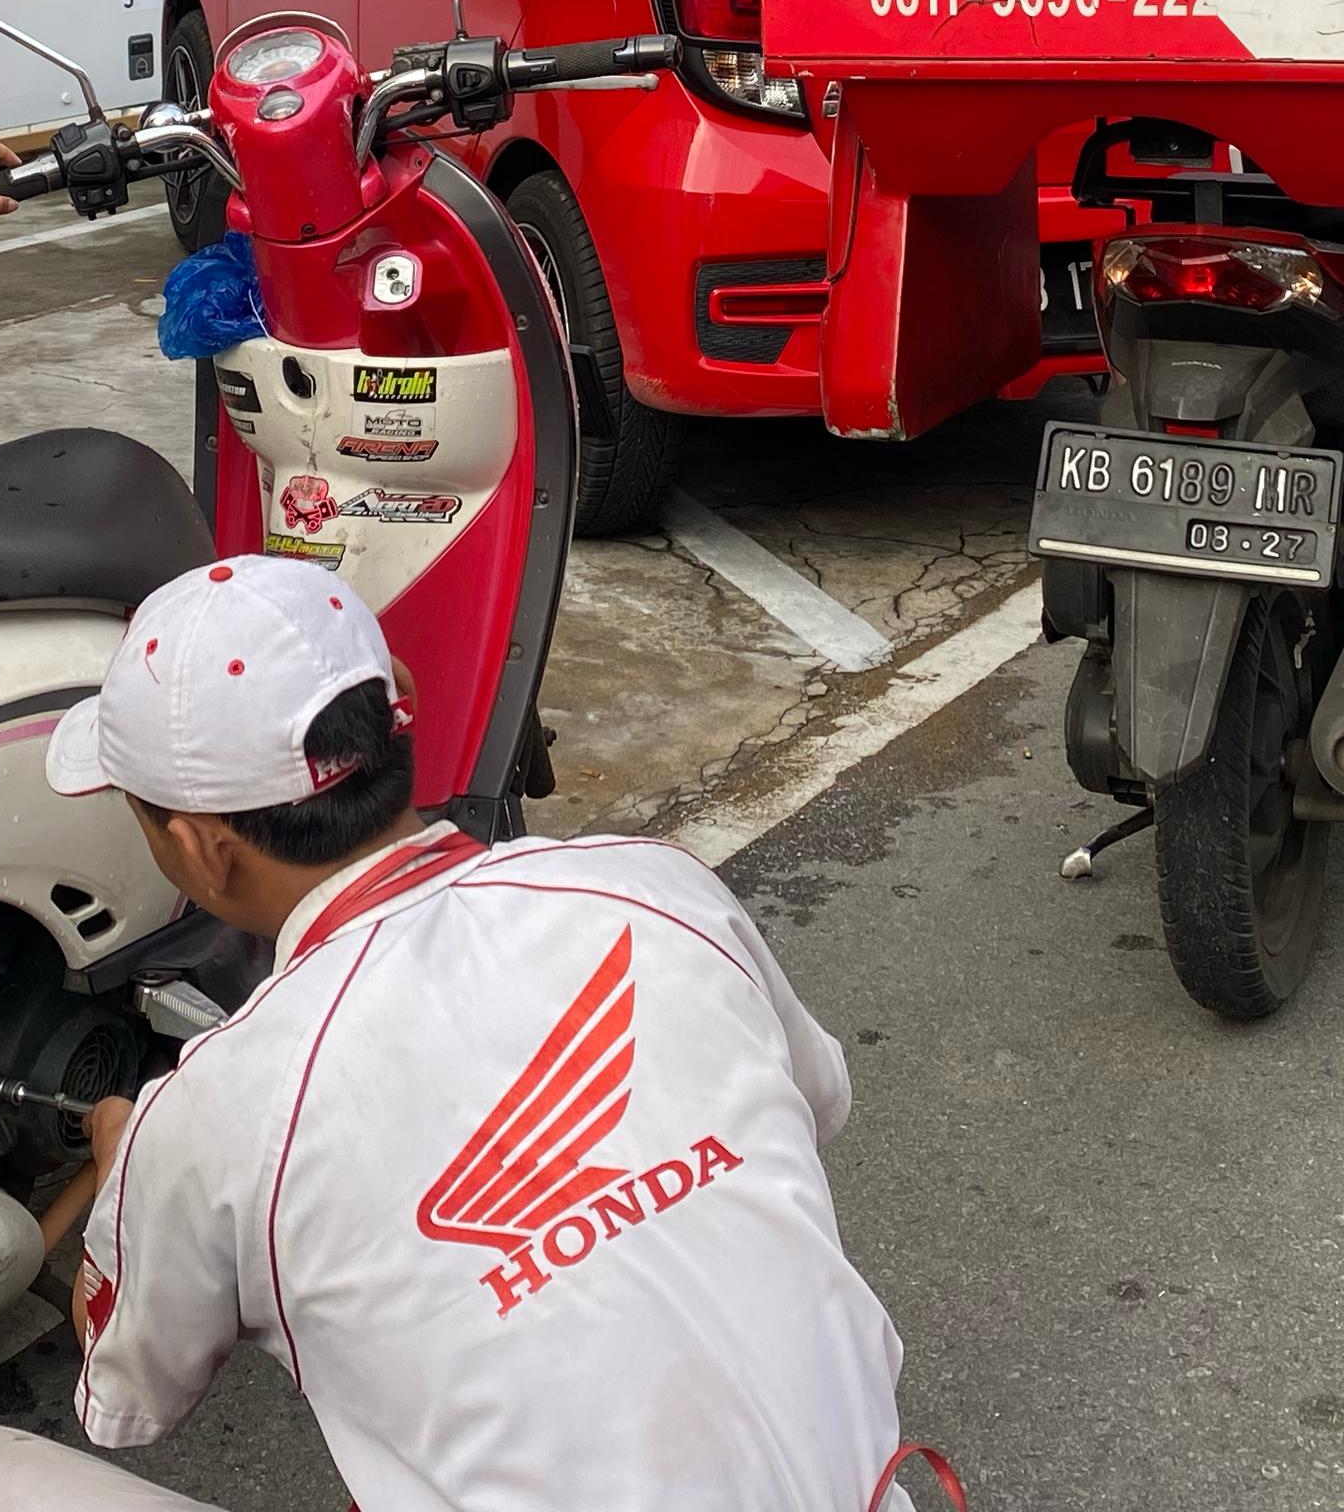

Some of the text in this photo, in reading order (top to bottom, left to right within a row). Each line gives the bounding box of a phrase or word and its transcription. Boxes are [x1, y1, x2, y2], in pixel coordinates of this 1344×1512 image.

[365, 414, 422, 427] MOTO
[1059, 446, 1111, 492] KB
[1130, 454, 1235, 506] 6189
[479, 1134, 744, 1320] HONDA
